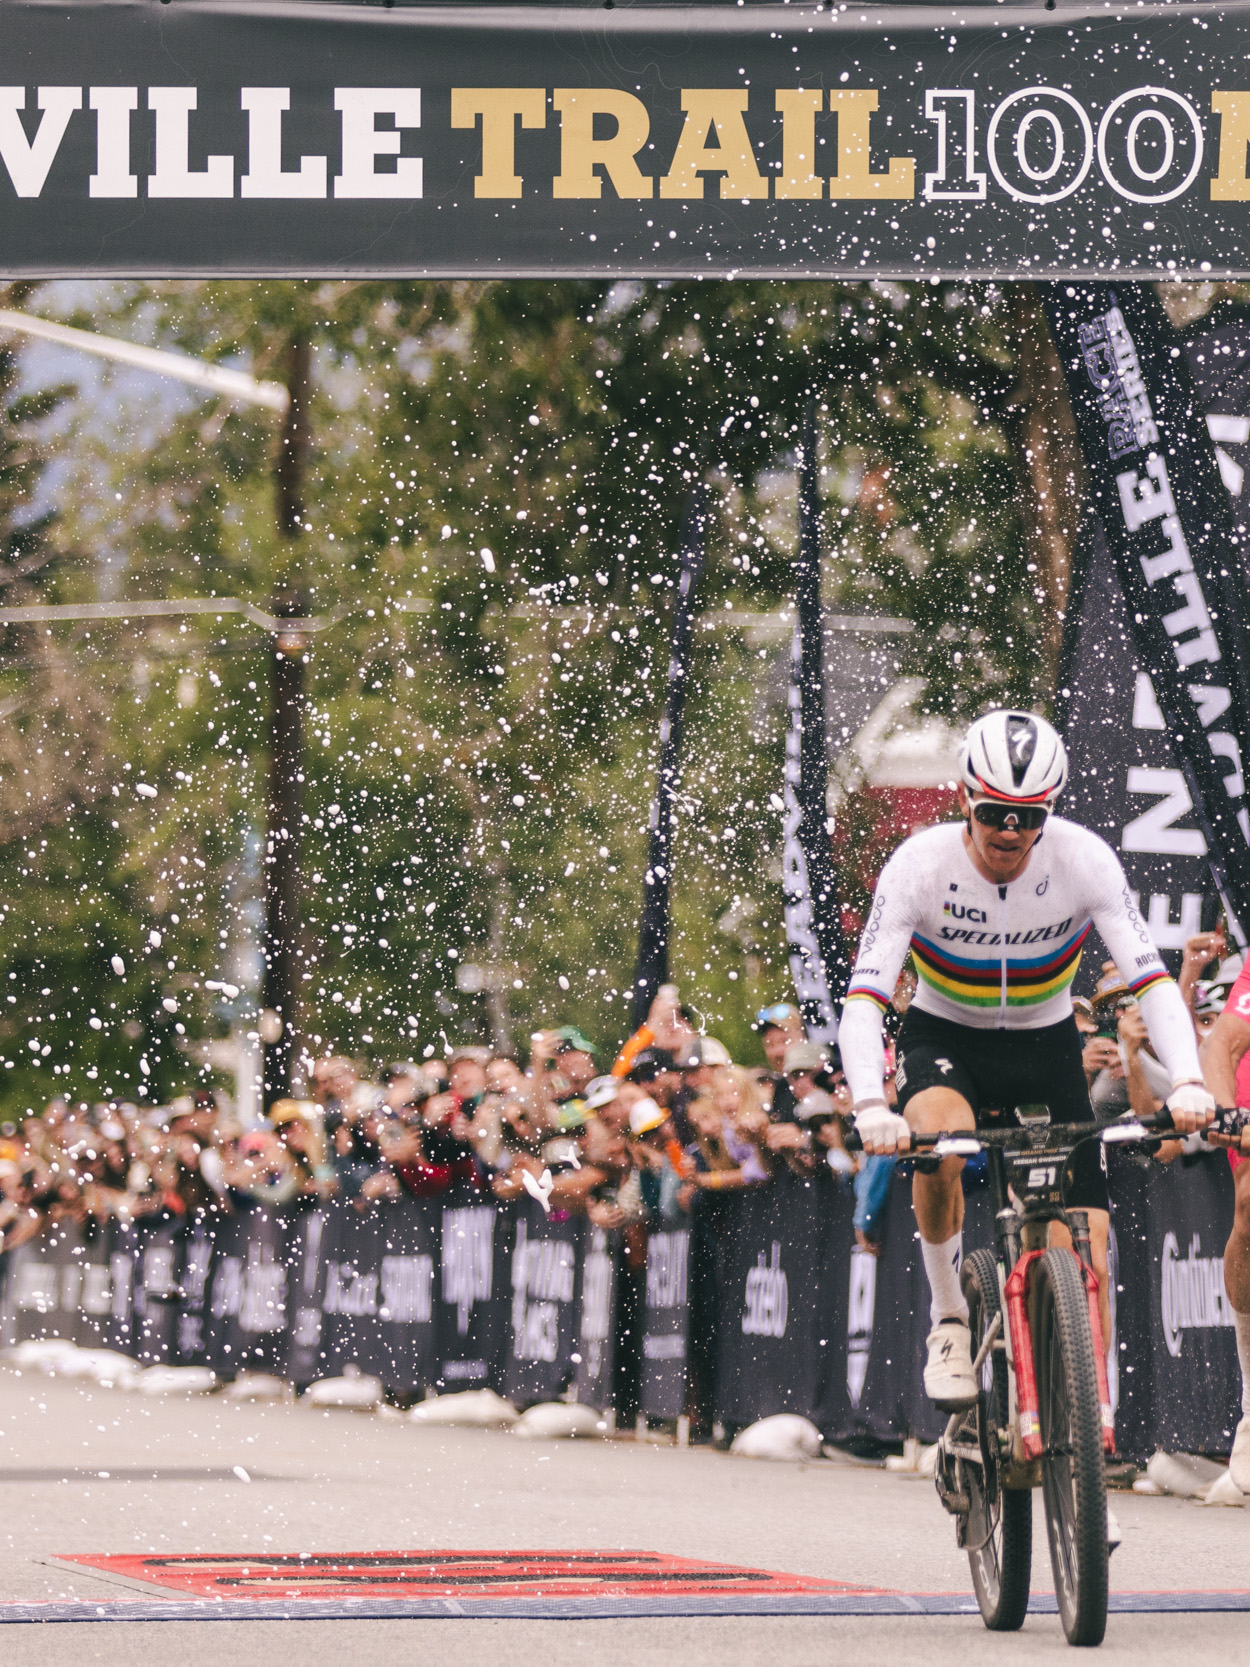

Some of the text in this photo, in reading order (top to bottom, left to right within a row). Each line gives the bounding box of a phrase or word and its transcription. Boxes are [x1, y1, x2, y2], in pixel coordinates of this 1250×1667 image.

[0, 87, 424, 199] VILLE
[450, 88, 915, 201] TRAIL
[924, 86, 1204, 204] 100
[951, 903, 987, 924] UCI
[936, 916, 1073, 946] SPECIALIZED
[1027, 1166, 1056, 1188] 51
